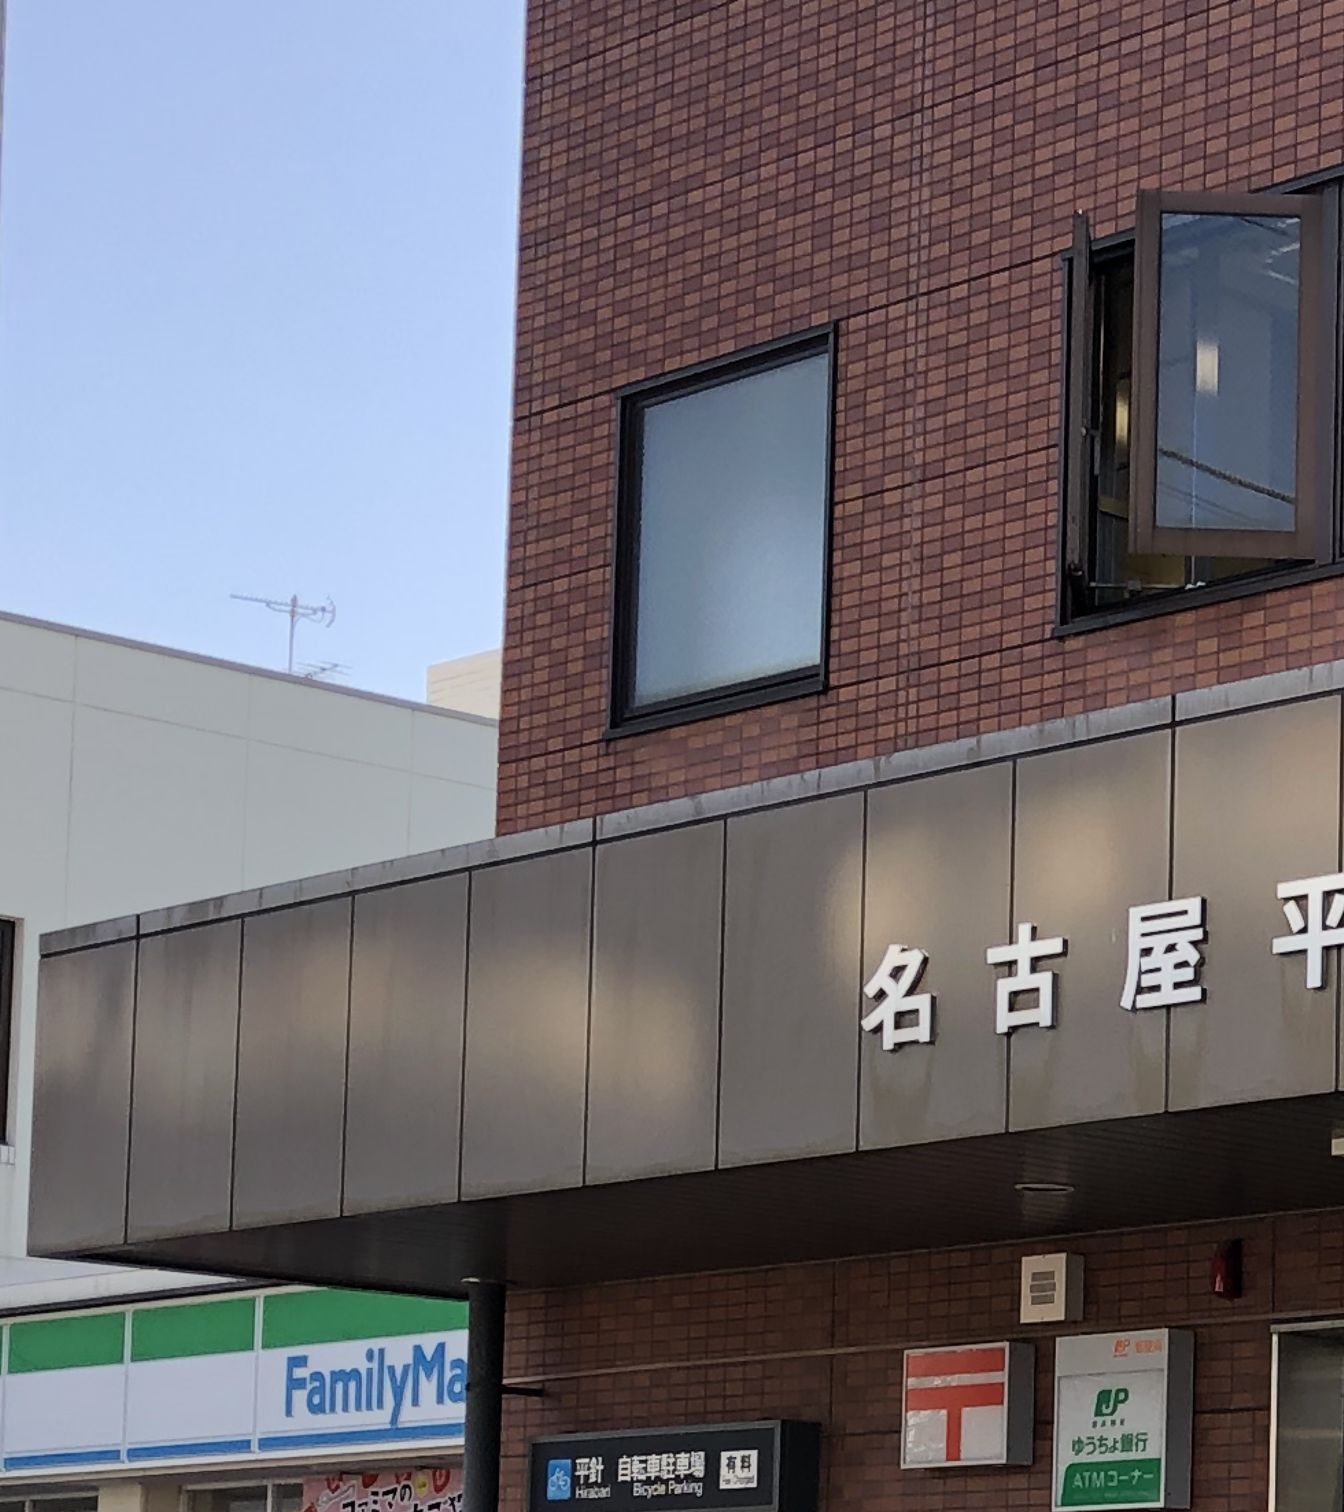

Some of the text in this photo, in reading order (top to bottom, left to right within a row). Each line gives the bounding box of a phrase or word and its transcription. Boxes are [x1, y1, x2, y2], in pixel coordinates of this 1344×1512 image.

[285, 1341, 468, 1428] FamilyMa
[1071, 1432, 1149, 1456] ゆうちょ銀行
[575, 1451, 706, 1484] 平針 自転車駐車場
[1072, 1469, 1154, 1489] ATMコーナー
[633, 1482, 666, 1499] Bicycle
[668, 1480, 703, 1497] Parking
